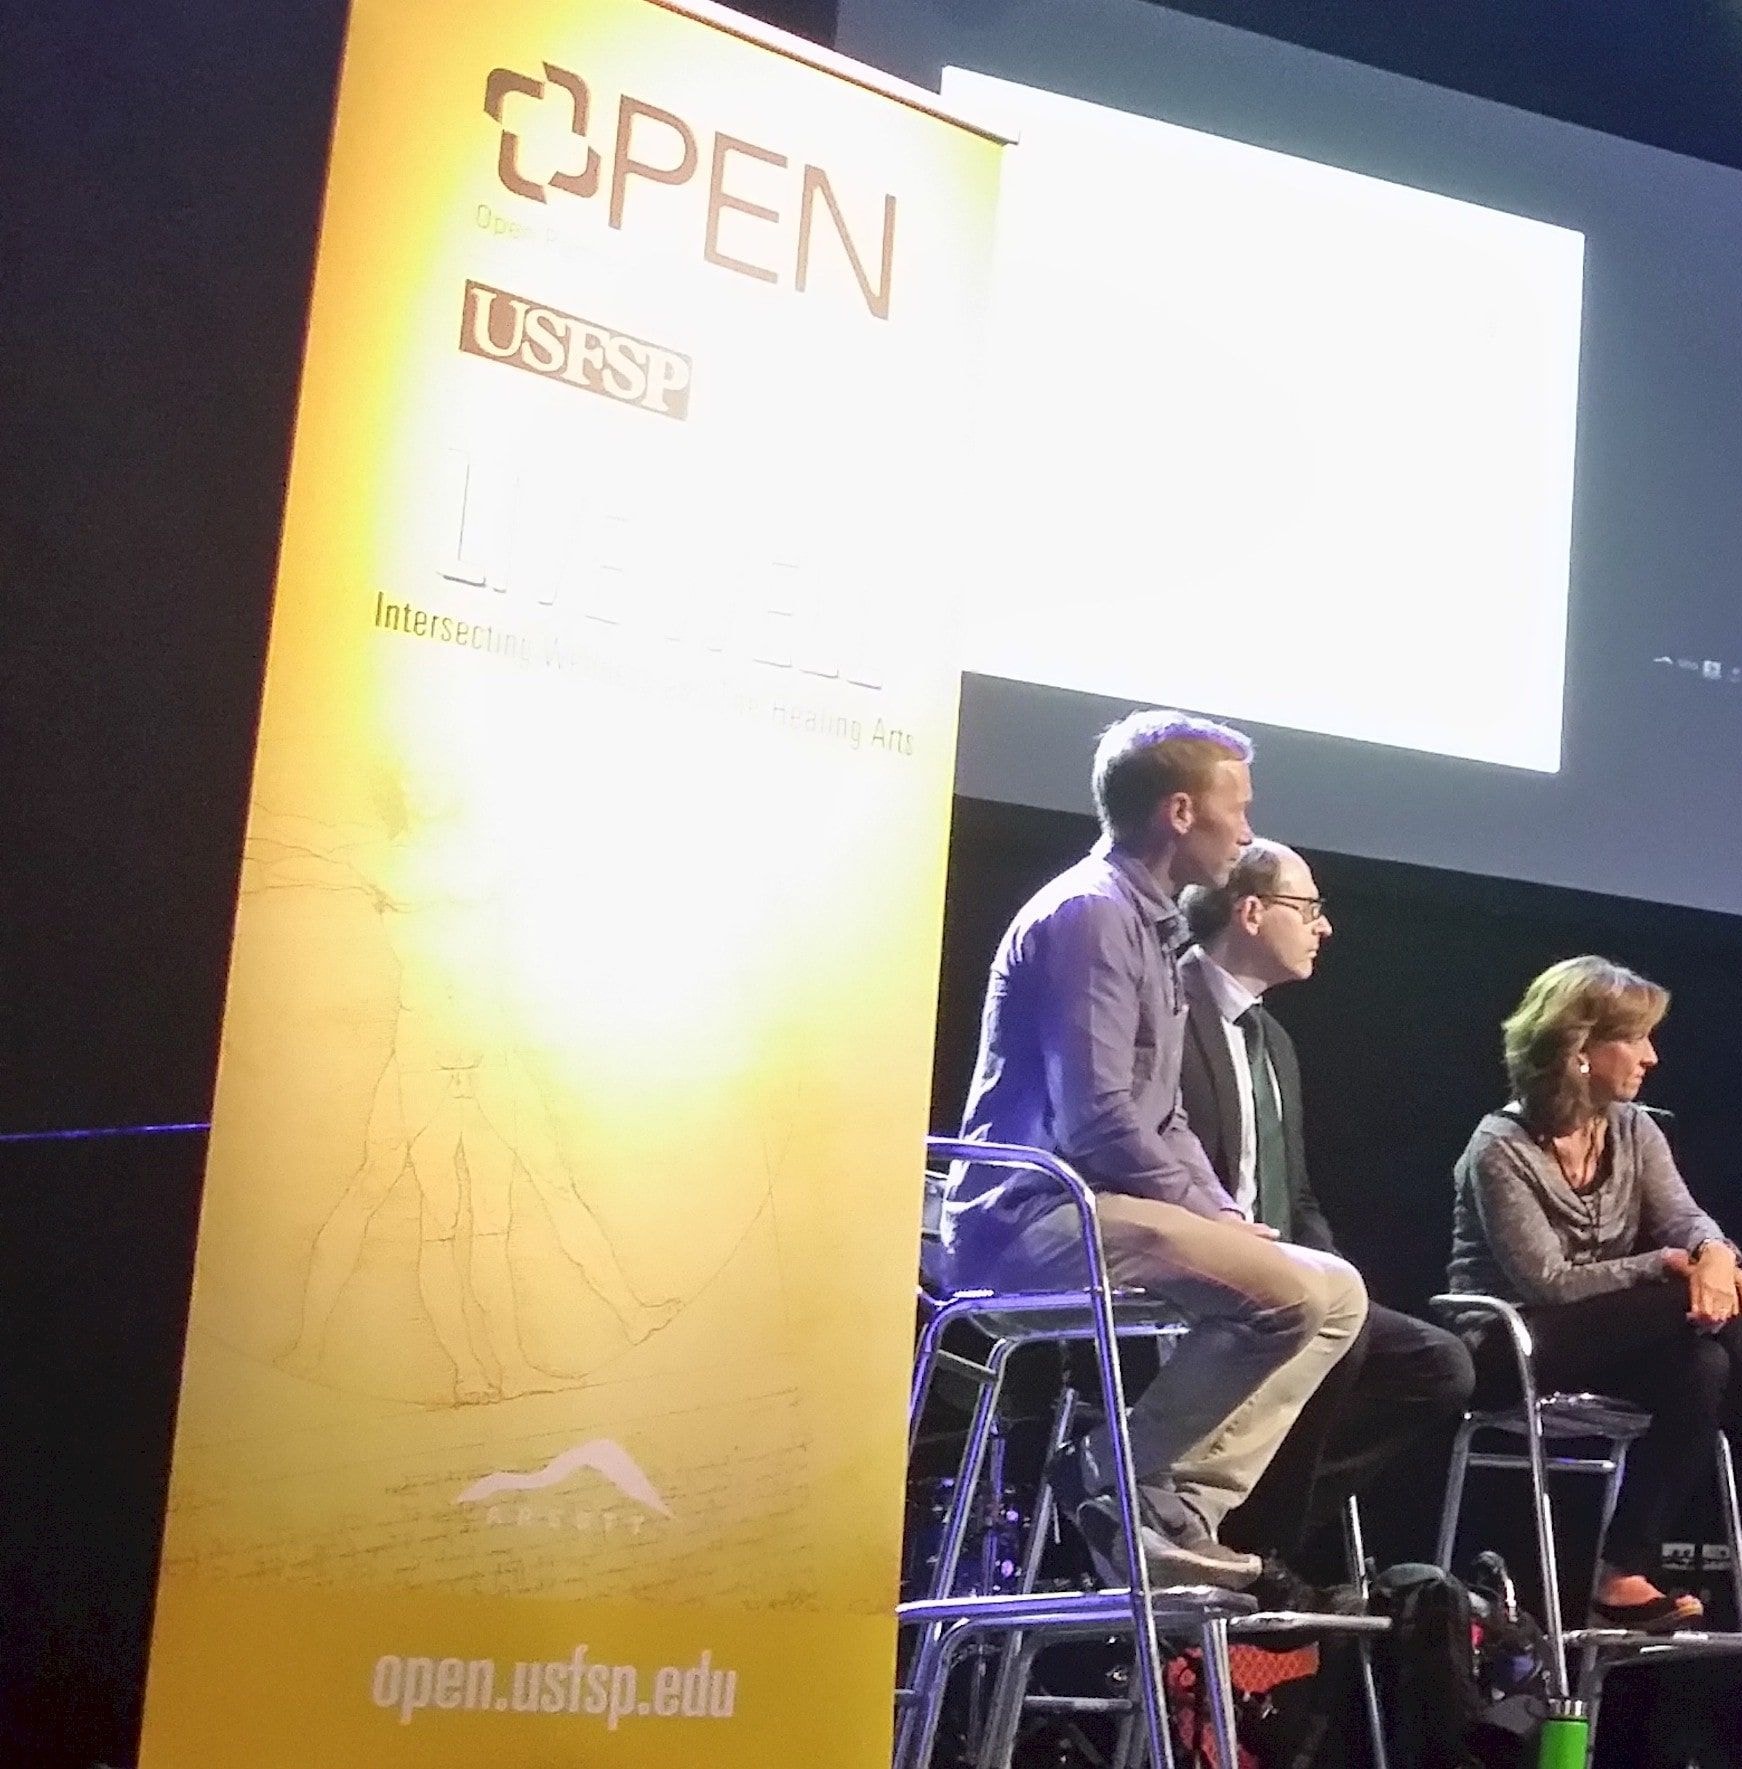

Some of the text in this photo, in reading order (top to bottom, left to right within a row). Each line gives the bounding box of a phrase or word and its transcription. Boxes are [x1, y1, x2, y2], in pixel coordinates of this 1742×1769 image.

[484, 61, 897, 320] OPEN
[469, 286, 690, 413] USFSP
[373, 1643, 737, 1731] open.usfsp.edu
